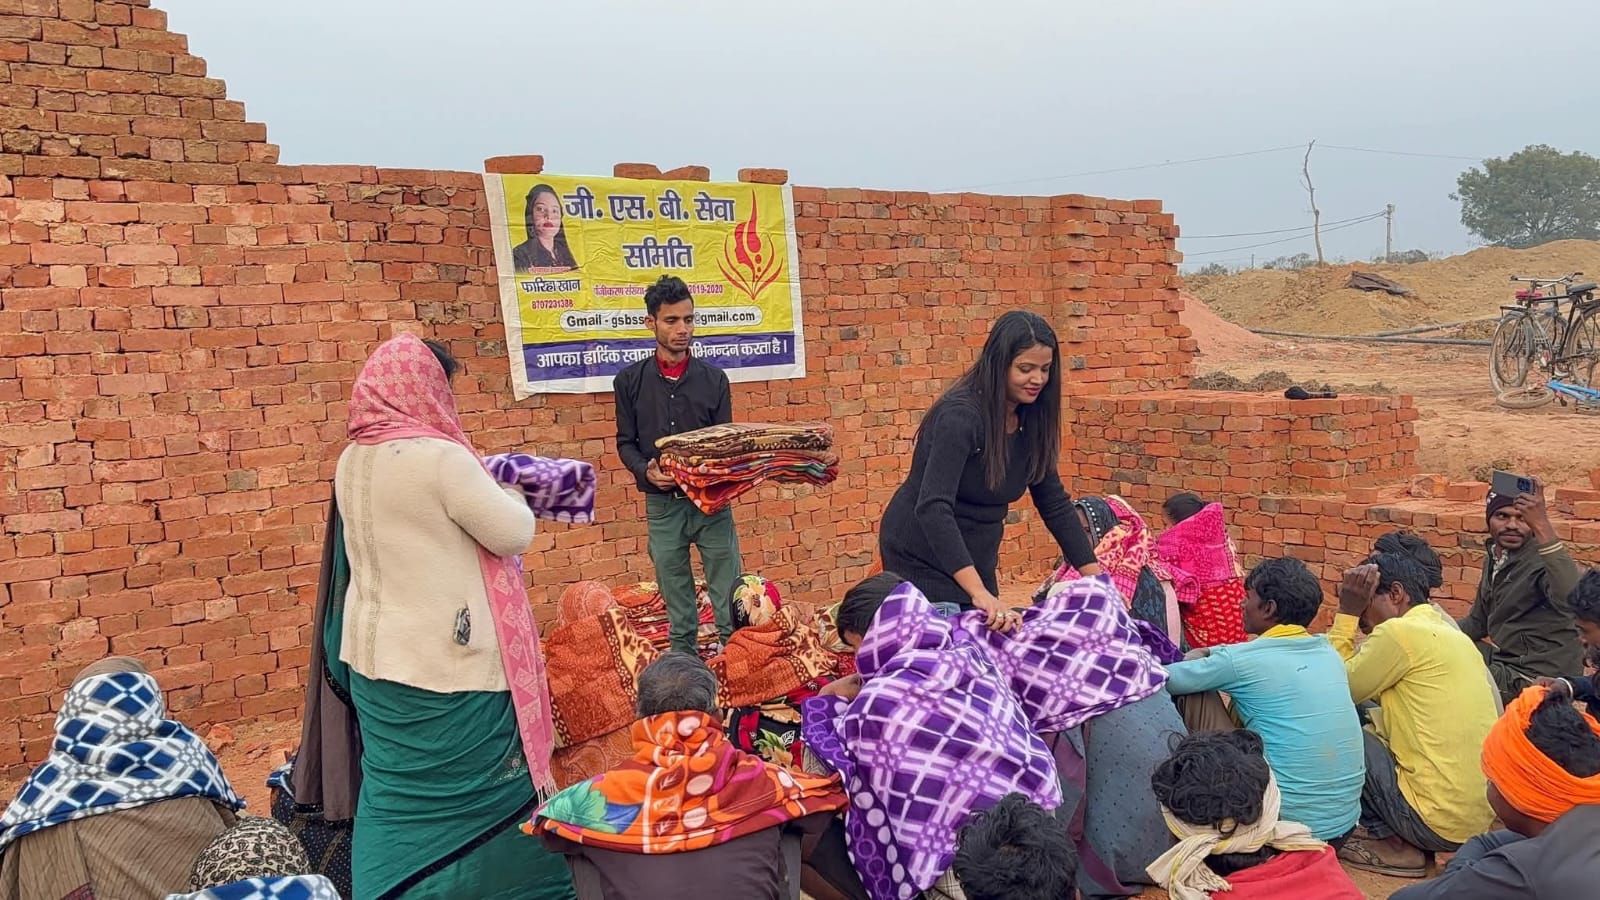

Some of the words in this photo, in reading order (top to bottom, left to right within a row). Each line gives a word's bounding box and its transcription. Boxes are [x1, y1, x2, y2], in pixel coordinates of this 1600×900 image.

[563, 187, 603, 219] जी.
[608, 195, 653, 221] एस.
[658, 189, 689, 220] बी.
[694, 191, 735, 221] सेवा
[622, 236, 692, 268] समिति
[521, 277, 556, 292] फारिहा
[557, 279, 580, 291] खान
[567, 313, 602, 327] Gmail
[537, 351, 580, 368] आपका
[582, 345, 620, 365] हार्दिक
[740, 342, 771, 355] करता
